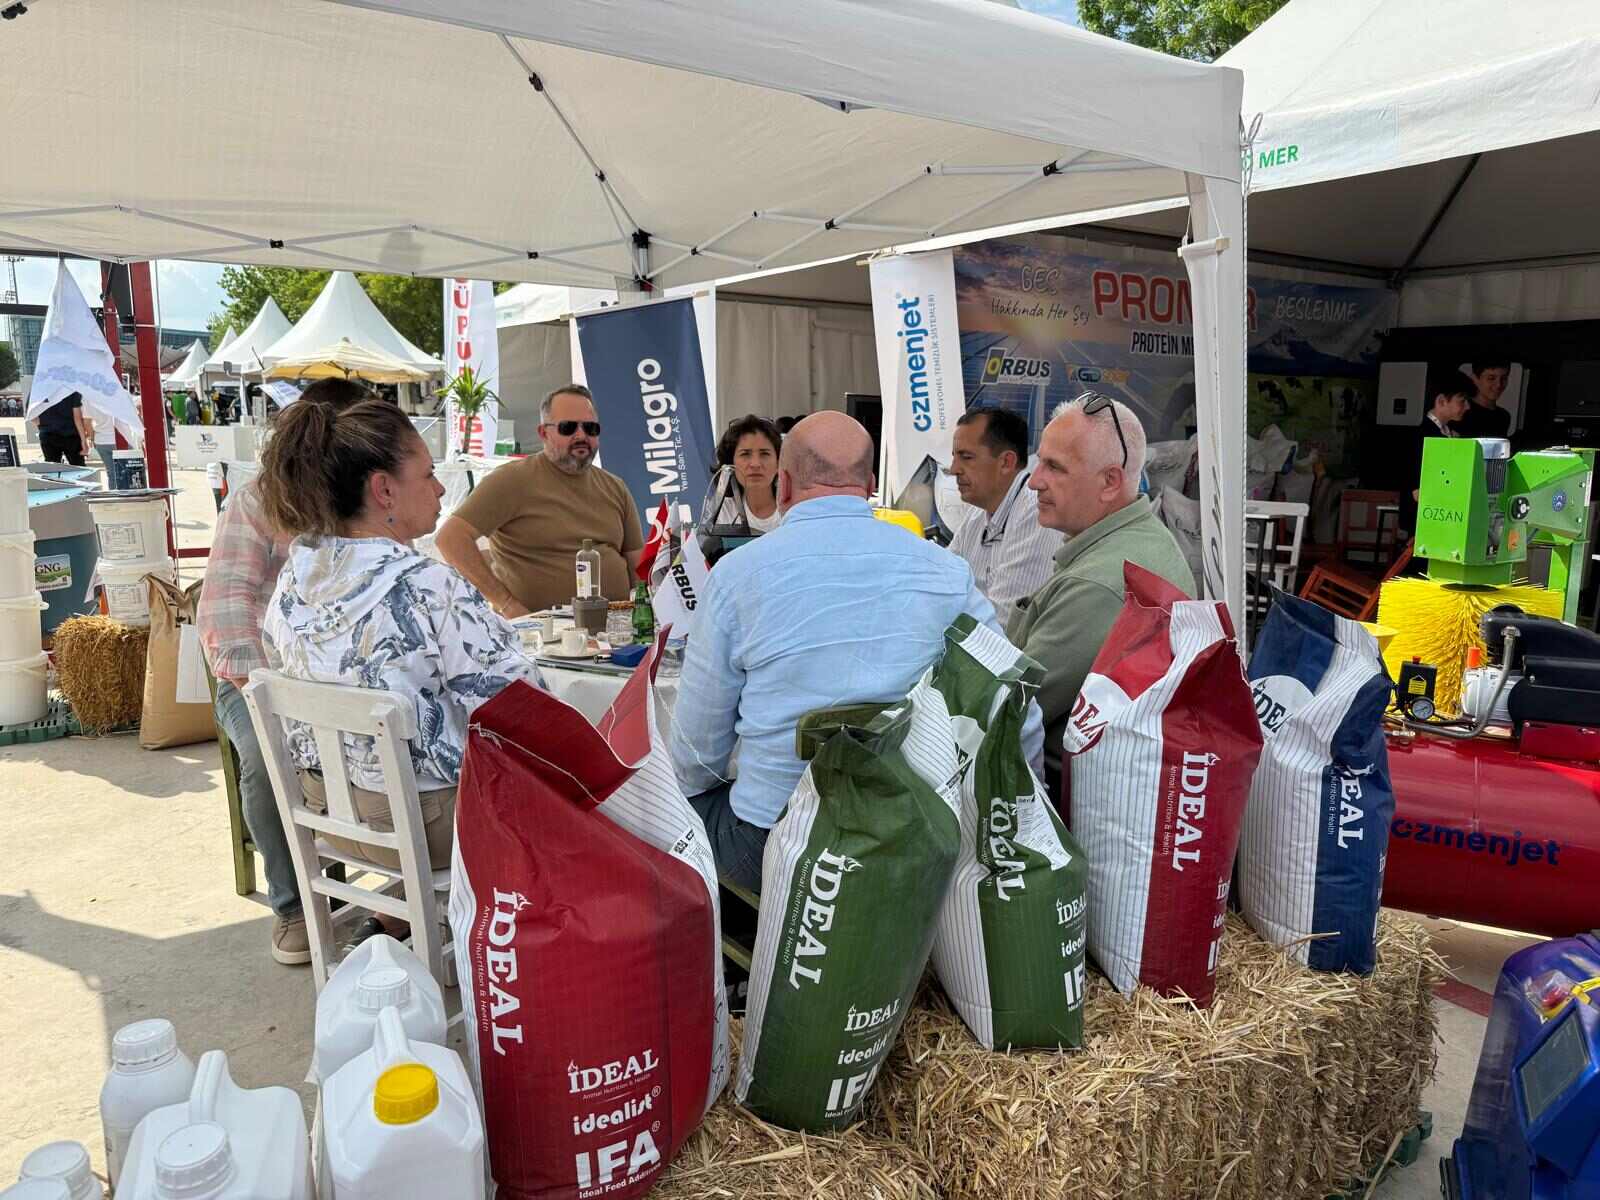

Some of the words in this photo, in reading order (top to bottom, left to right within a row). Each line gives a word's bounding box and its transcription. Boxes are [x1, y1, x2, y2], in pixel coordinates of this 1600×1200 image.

[1259, 145, 1298, 168] MER
[1047, 304, 1067, 320] Her
[1274, 296, 1360, 322] BESLENME
[1130, 330, 1178, 355] PROTEİN
[986, 354, 1050, 379] ORBUS
[637, 358, 680, 494] Milagro
[680, 472, 688, 491] Yem
[35, 562, 61, 575] GNG
[478, 906, 490, 940] Animal
[475, 942, 485, 986] Nutrition
[481, 1000, 489, 1032] Health
[579, 1186, 603, 1199] Ideal
[605, 1179, 626, 1193] Feed
